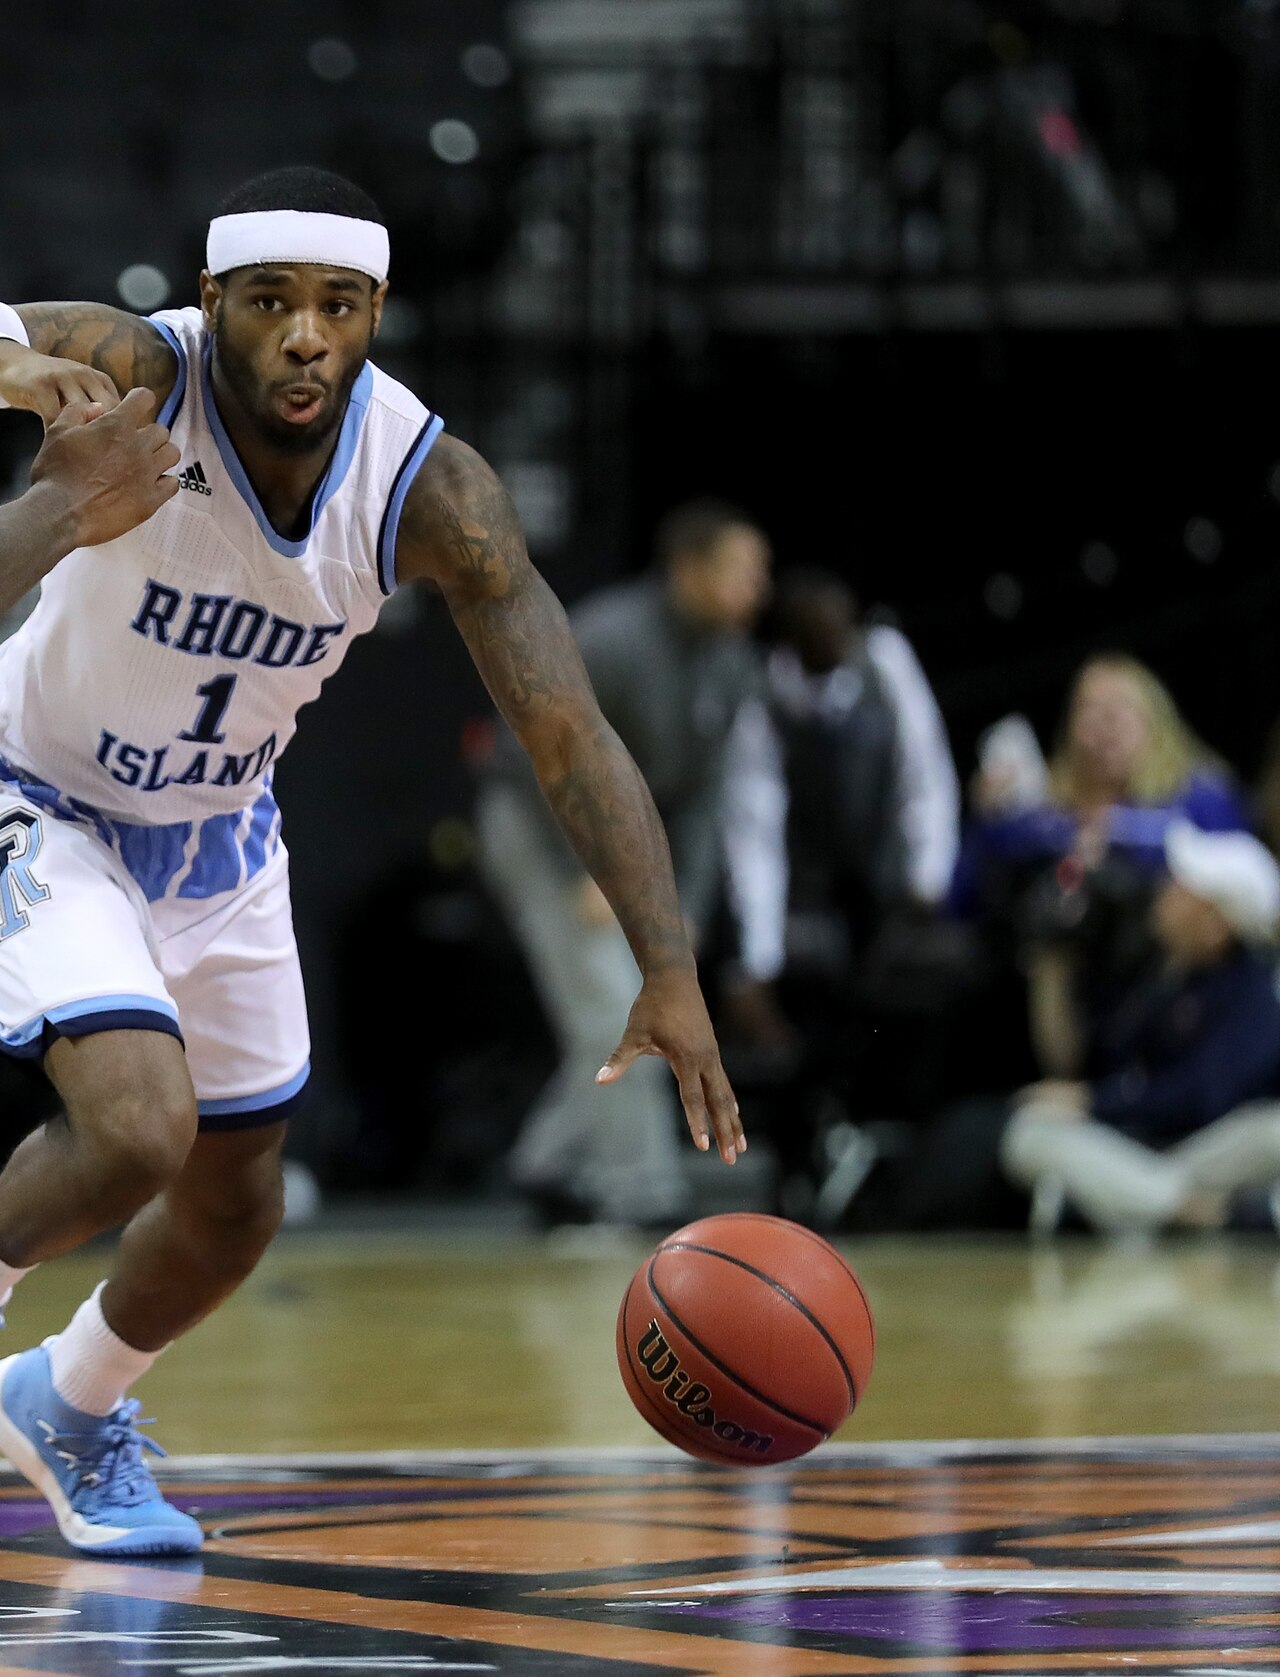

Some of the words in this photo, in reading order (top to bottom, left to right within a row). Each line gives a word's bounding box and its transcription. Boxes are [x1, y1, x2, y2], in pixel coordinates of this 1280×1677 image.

[129, 577, 349, 668] RHODE
[176, 673, 238, 745] 1
[95, 728, 278, 792] ISLAND
[637, 1318, 775, 1454] Wilson
